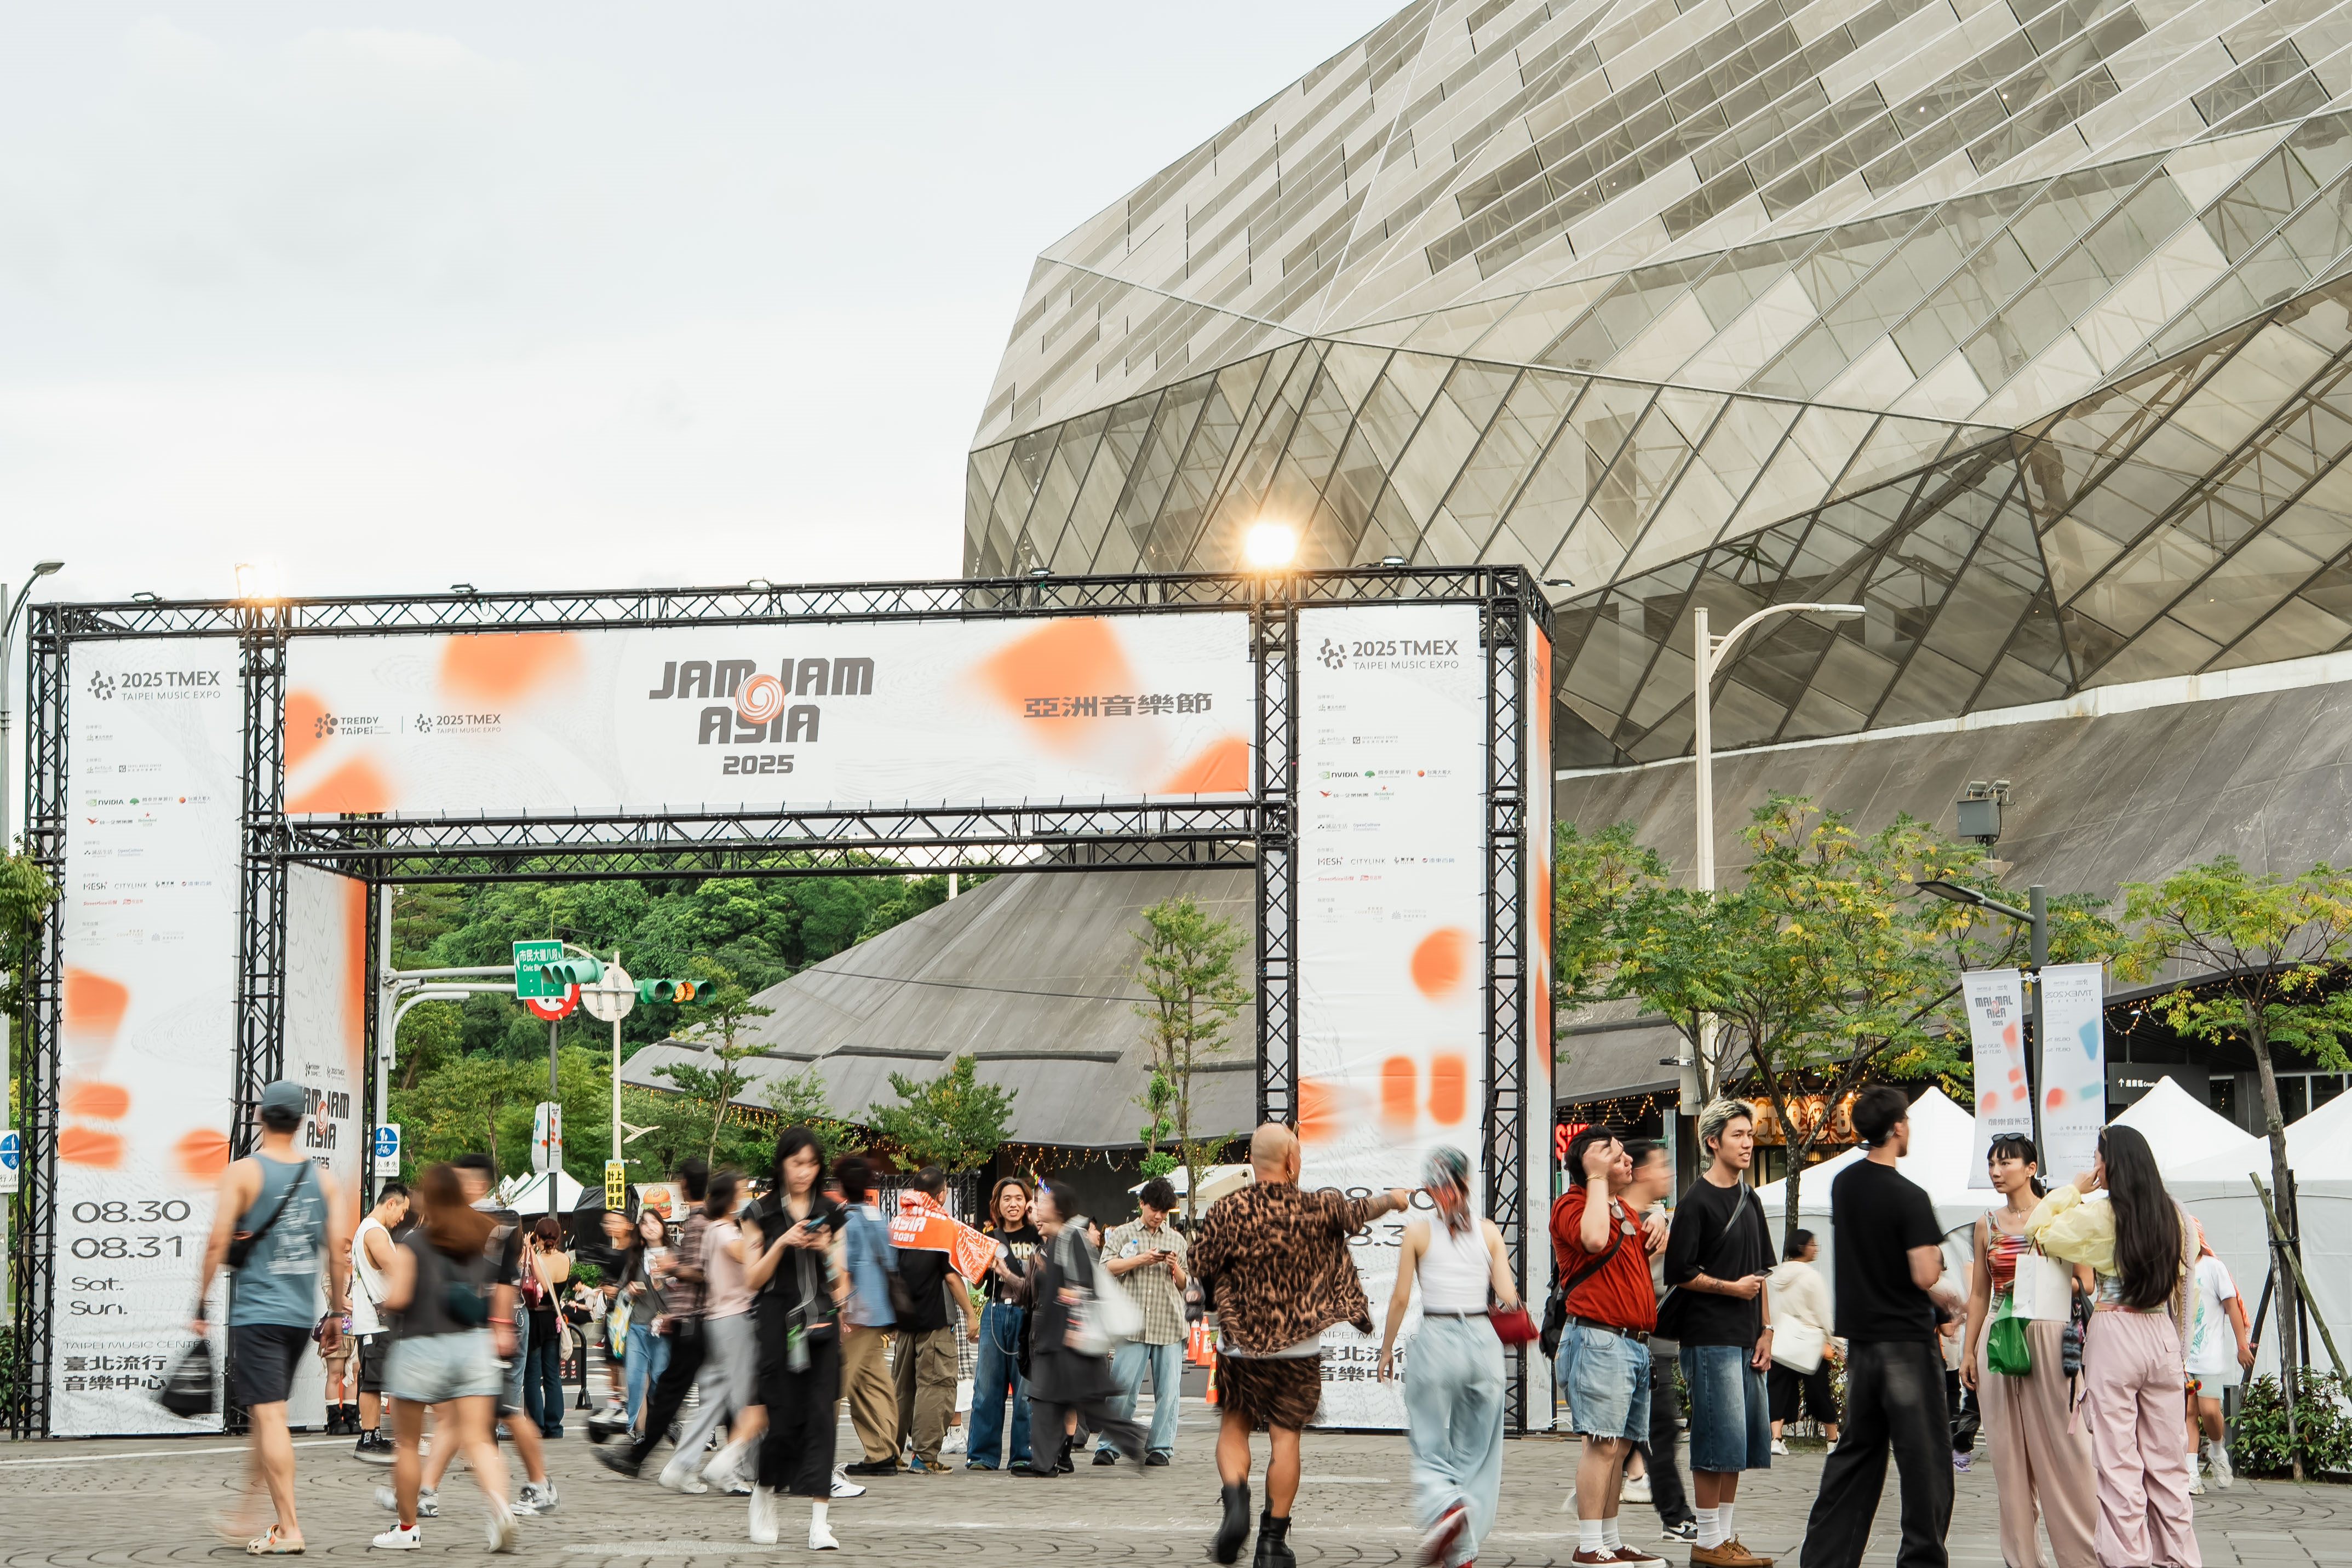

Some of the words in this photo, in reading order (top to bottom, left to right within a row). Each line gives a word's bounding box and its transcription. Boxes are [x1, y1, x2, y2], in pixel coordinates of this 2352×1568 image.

[1352, 640, 1397, 657] 2025
[1399, 640, 1459, 656] TMEX
[1353, 662, 1387, 670] TAIPEI
[1391, 660, 1426, 669] MUSIC
[1430, 660, 1459, 669] EXPO
[121, 672, 163, 688] 2025
[165, 671, 221, 687] TMEX
[649, 659, 756, 699] JAM
[779, 657, 875, 697] JAM
[121, 692, 153, 701] TAIPEI
[157, 691, 190, 700] MUSIC
[193, 691, 221, 699] EXPO
[1023, 692, 1213, 719] 亞洲音樂節
[437, 715, 463, 725] 2025
[466, 714, 501, 725] TMEX
[698, 704, 821, 745] ASIA
[722, 754, 795, 775] 2025
[114, 882, 148, 890] CITYLINK
[519, 948, 558, 962] 市民大道八段
[302, 1087, 322, 1115] AM
[326, 1090, 350, 1119] JAM
[306, 1121, 337, 1150] ASIA
[615, 1171, 623, 1207] 上車處
[72, 1200, 191, 1224] 08.30
[891, 1216, 927, 1232] ASIA
[893, 1232, 916, 1243] 2025
[71, 1236, 182, 1259] 08.31
[70, 1301, 128, 1315] Sun.
[1319, 1330, 1353, 1339] AIPEI
[65, 1341, 104, 1350] TAIPEI
[108, 1340, 153, 1349] MUSIC
[64, 1355, 167, 1372] 臺北流行
[63, 1374, 167, 1392] 音樂中心
